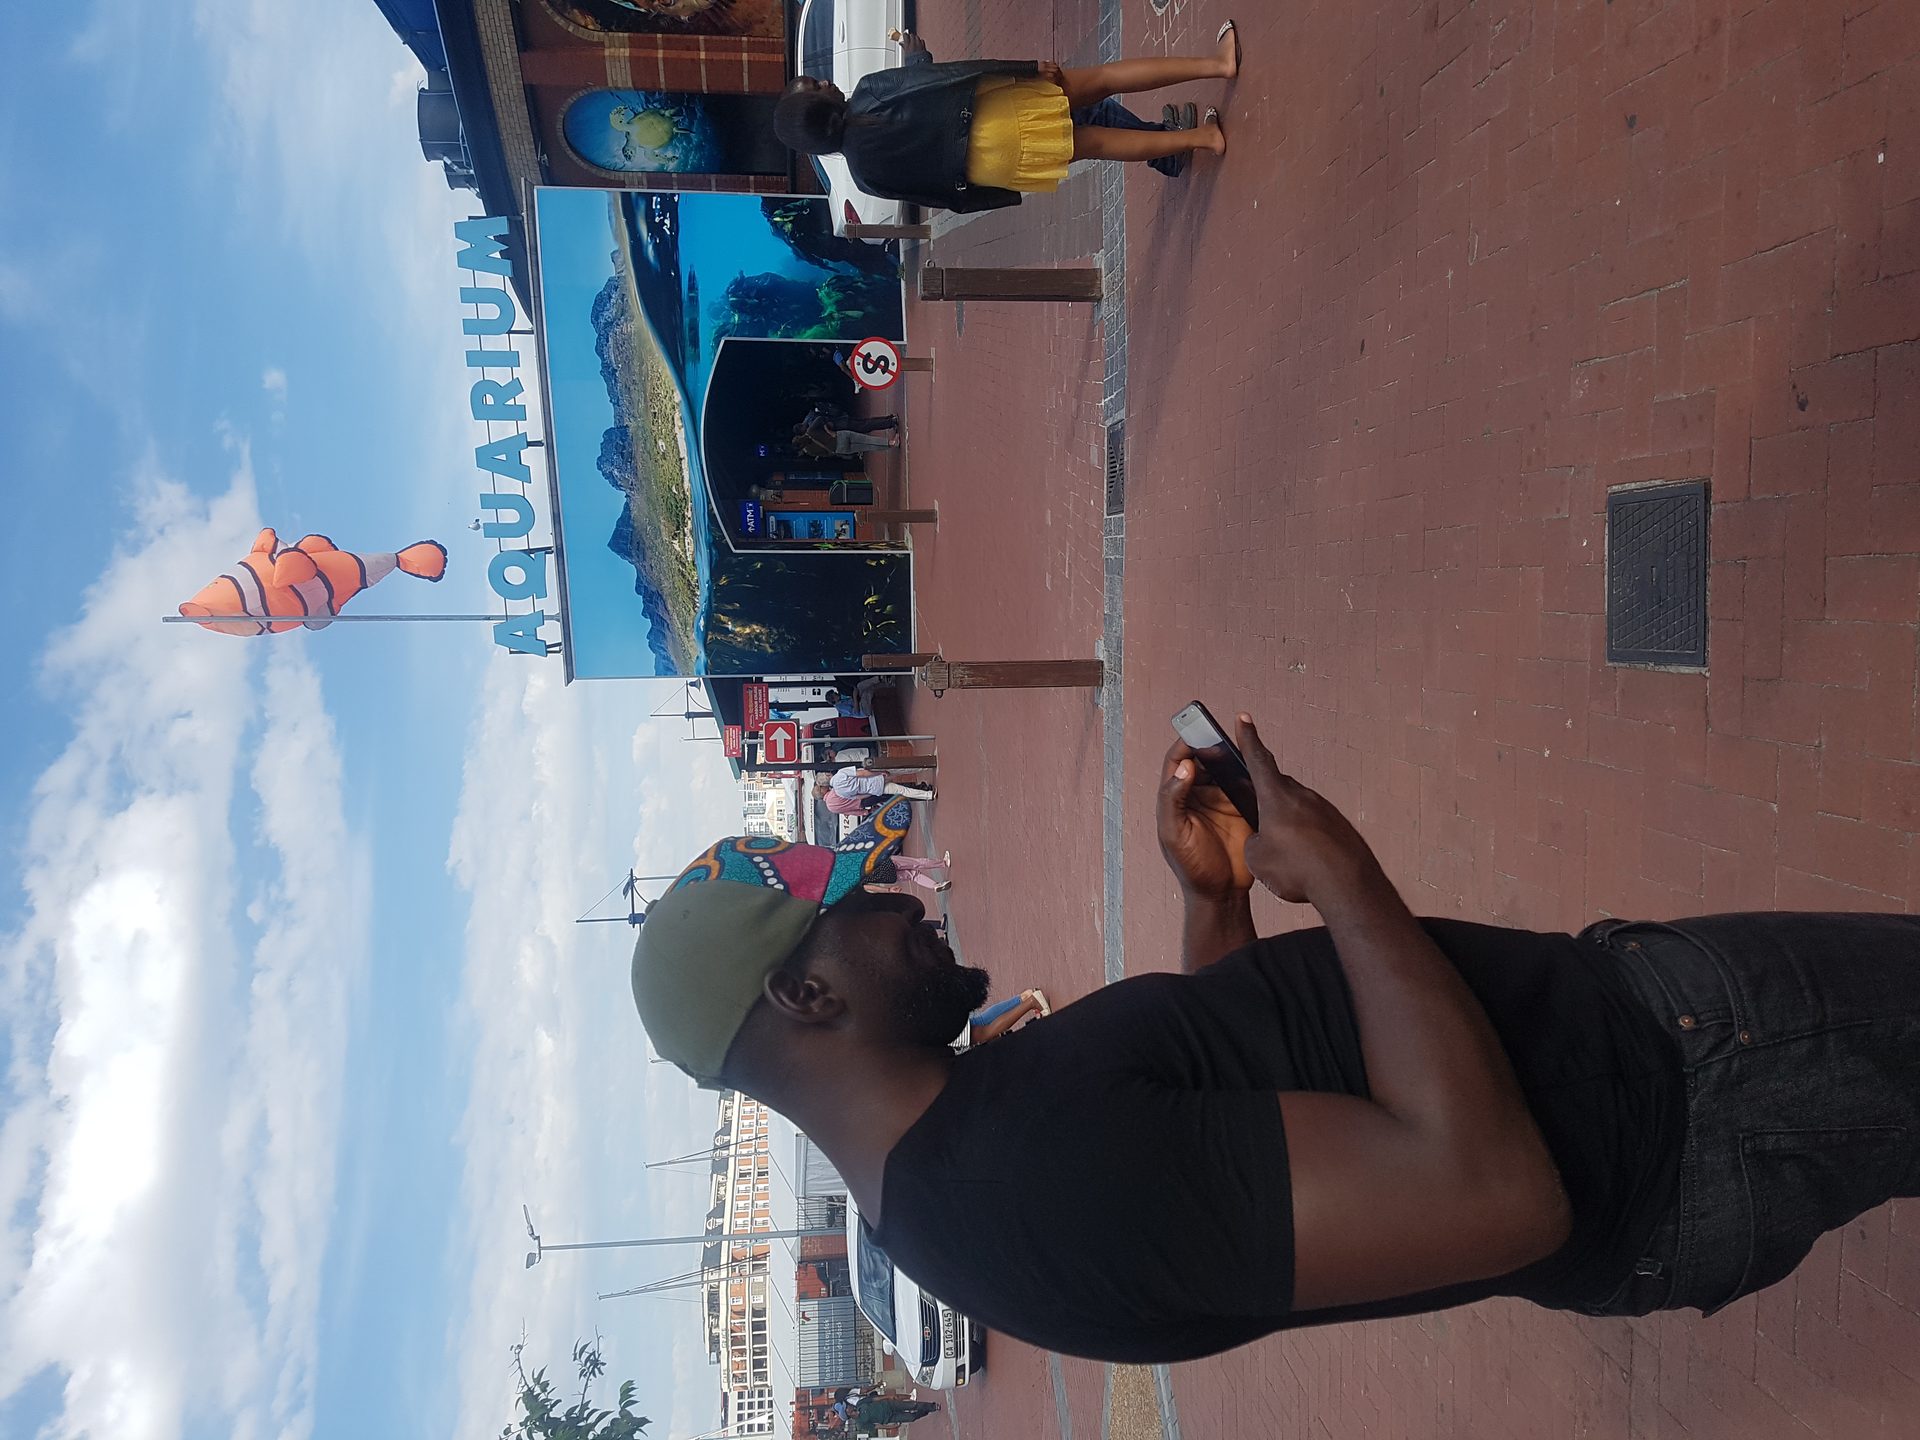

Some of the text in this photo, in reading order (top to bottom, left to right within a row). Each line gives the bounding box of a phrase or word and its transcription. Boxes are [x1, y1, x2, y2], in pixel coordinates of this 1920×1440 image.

[454, 215, 547, 657] AQUARIUM
[746, 509, 755, 527] ATM
[945, 1346, 954, 1356] CA
